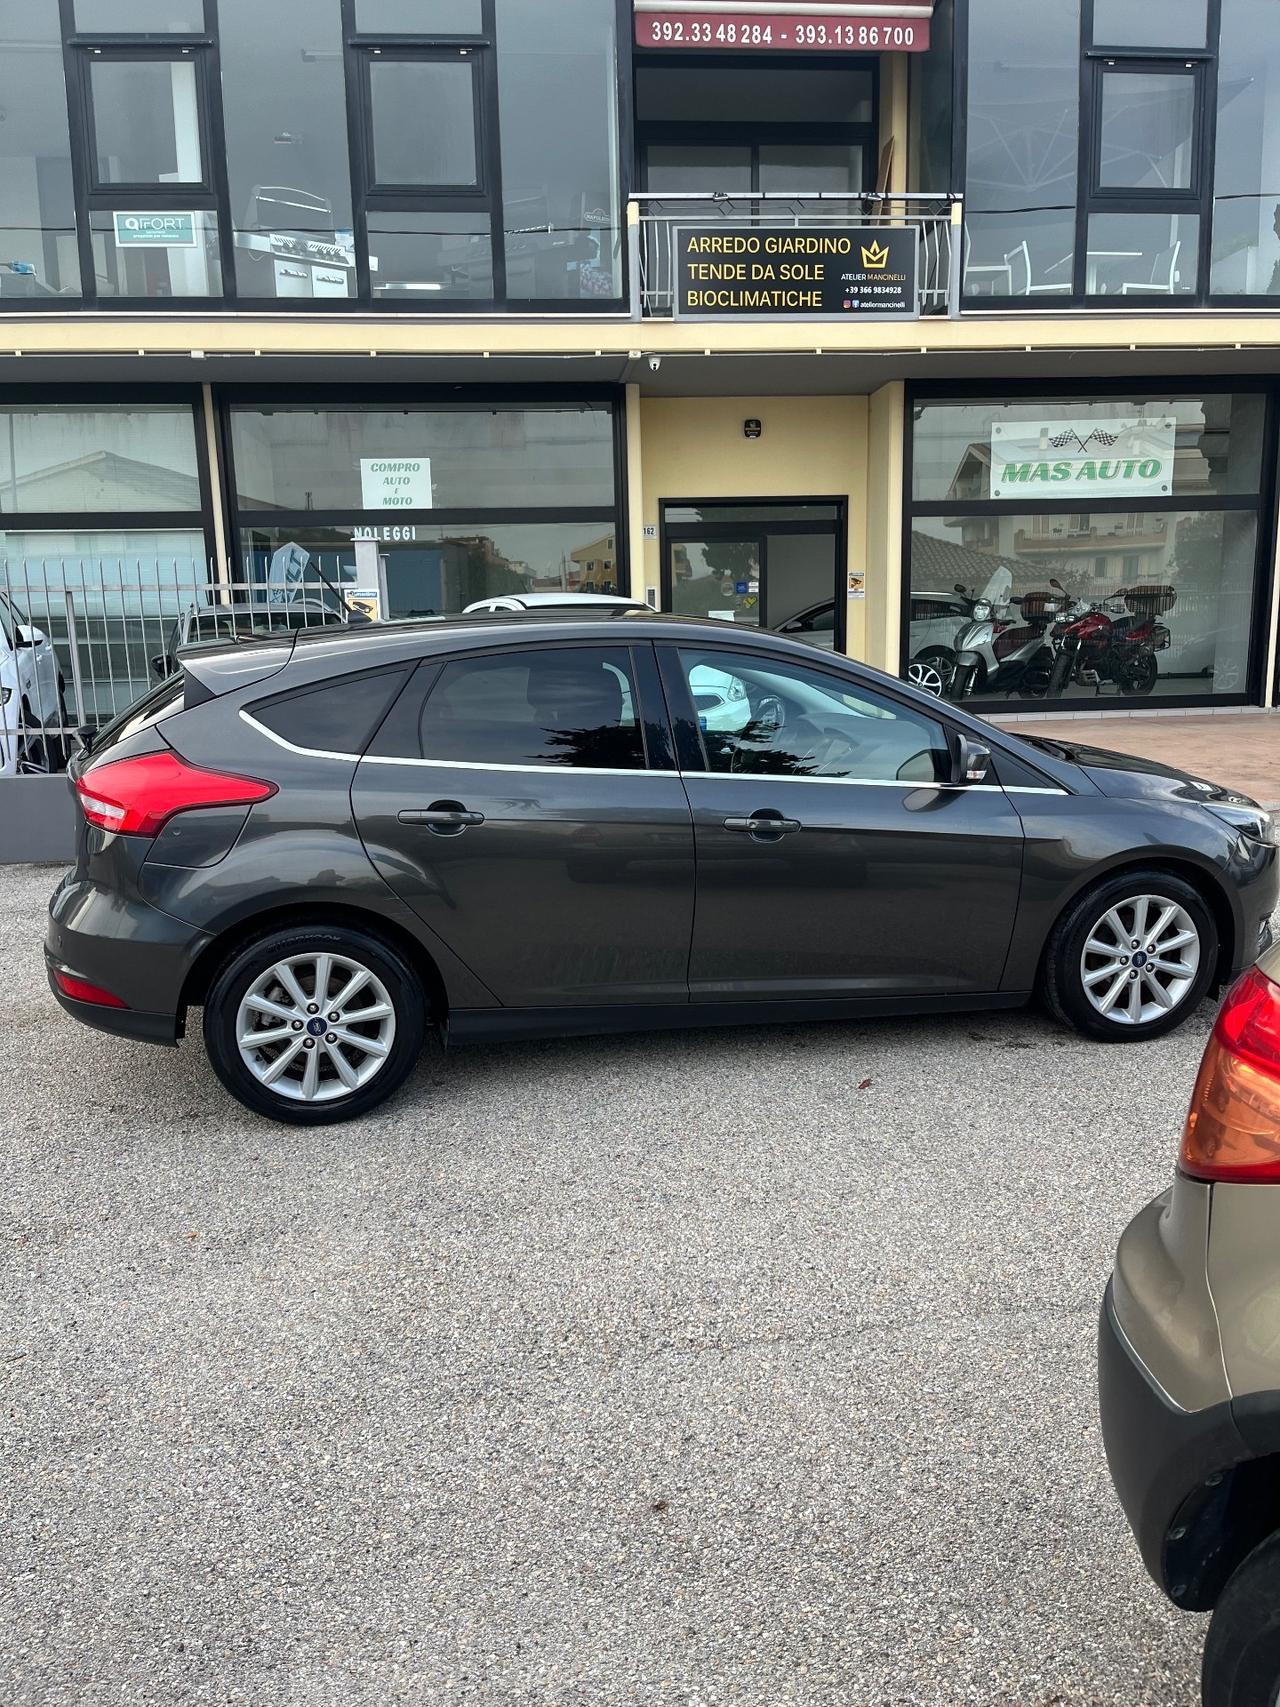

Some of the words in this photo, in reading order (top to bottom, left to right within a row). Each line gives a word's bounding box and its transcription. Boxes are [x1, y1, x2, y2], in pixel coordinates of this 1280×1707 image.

[687, 236, 760, 253] ARREDO
[764, 237, 851, 254] GIARDINO
[687, 263, 747, 280] TENDE
[751, 264, 776, 280] DA
[779, 264, 825, 280] SOLE
[840, 273, 867, 281] ATELIER
[867, 273, 906, 281] MANCINELLI
[845, 286, 859, 294] +39
[859, 286, 872, 294] 366
[873, 286, 902, 294] 9834928
[687, 290, 823, 307] BIOCLIMATICHE
[860, 301, 906, 309] ateliermancinelli
[370, 462, 421, 473] COMPRO
[1001, 461, 1072, 483] MAS
[1075, 459, 1162, 481] AUTO
[382, 476, 411, 486] AUTO
[382, 496, 413, 506] MOTO
[353, 526, 416, 541] NOLEGGI
[643, 527, 655, 535] 162
